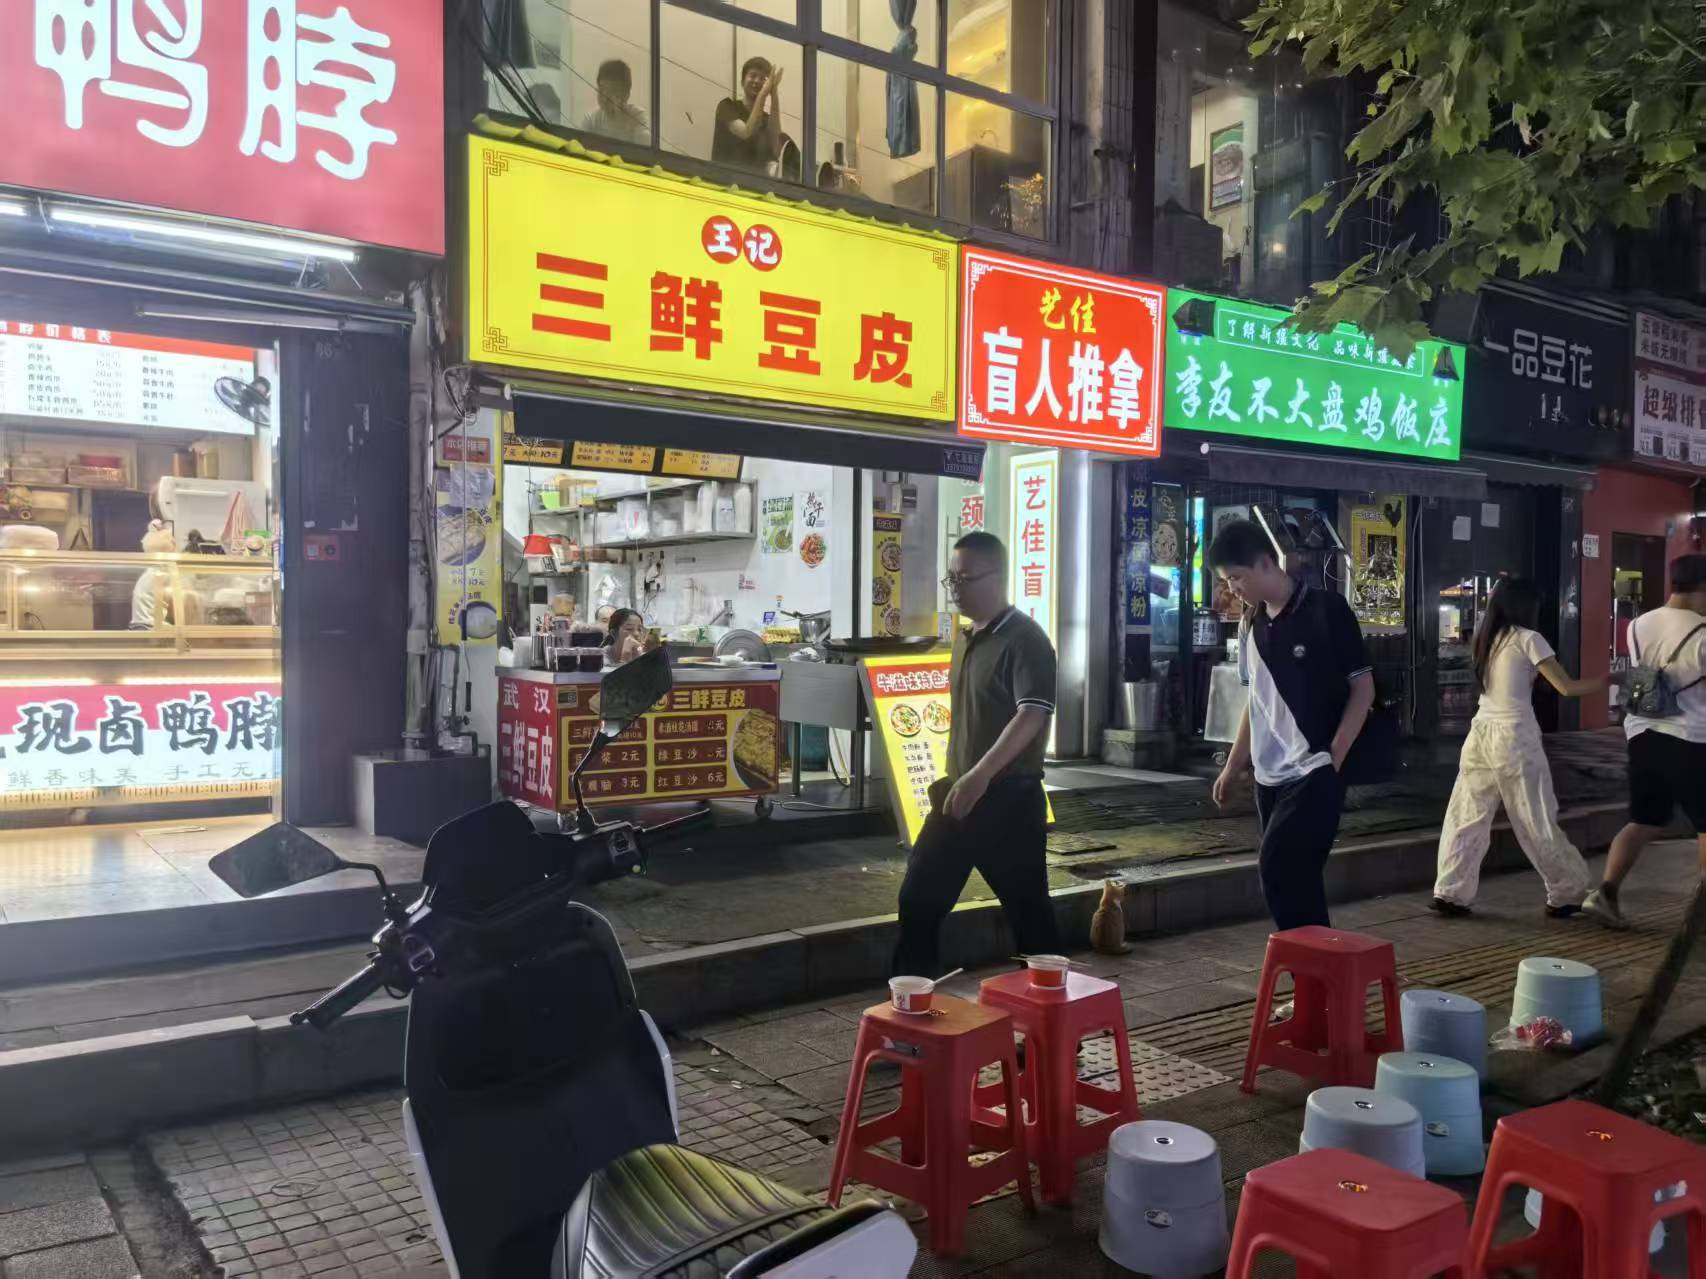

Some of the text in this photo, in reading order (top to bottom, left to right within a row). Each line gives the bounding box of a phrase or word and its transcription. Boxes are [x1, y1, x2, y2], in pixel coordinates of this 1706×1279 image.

[35, 0, 397, 180] 鸭脖
[706, 222, 781, 266] 王记
[532, 252, 913, 389] 三鲜豆皮
[1040, 287, 1097, 334] 艺佳
[983, 326, 1144, 430] 盲人推拿
[1483, 327, 1593, 389] 一品豆花
[961, 495, 985, 529] 颈
[504, 682, 550, 715] 武汉
[672, 688, 746, 710] 三鲜豆皮
[656, 772, 725, 787] 红豆沙 6元
